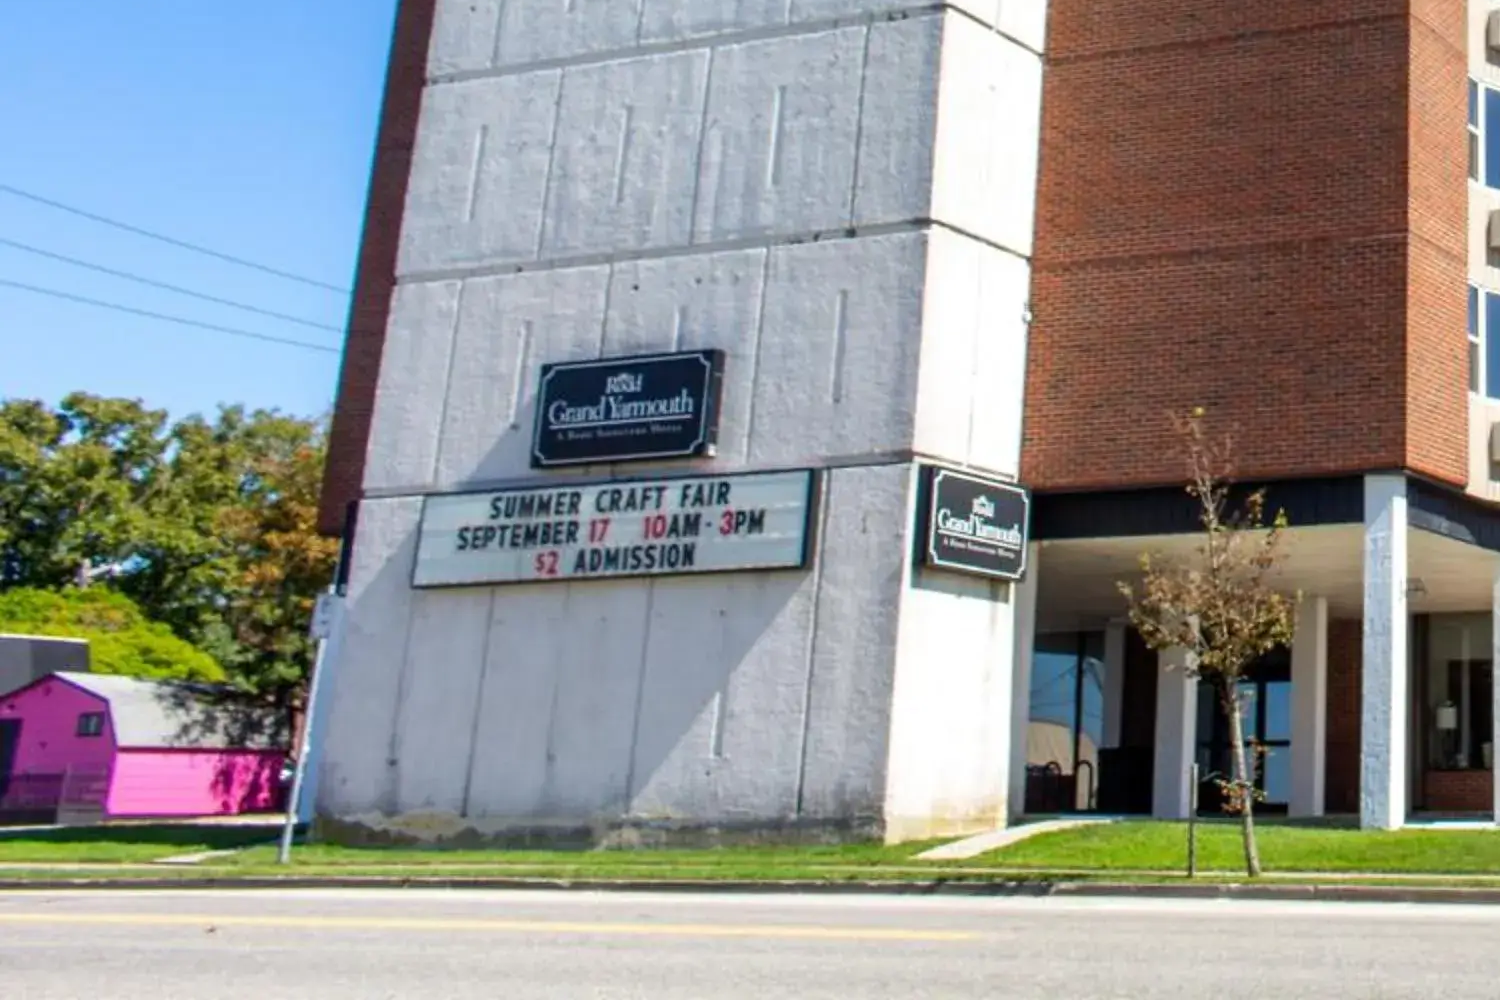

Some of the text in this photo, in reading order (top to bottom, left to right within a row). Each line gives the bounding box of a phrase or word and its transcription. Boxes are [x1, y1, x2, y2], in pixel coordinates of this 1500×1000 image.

[548, 388, 694, 425] Grand Yarmouth
[489, 481, 731, 520] SUMMER CRAFT FAIR
[456, 521, 580, 551] SEPTEMBER
[588, 518, 611, 544] 17
[643, 513, 703, 540] 10AM
[719, 508, 766, 537] 3PM
[573, 542, 696, 574] ADMISSION
